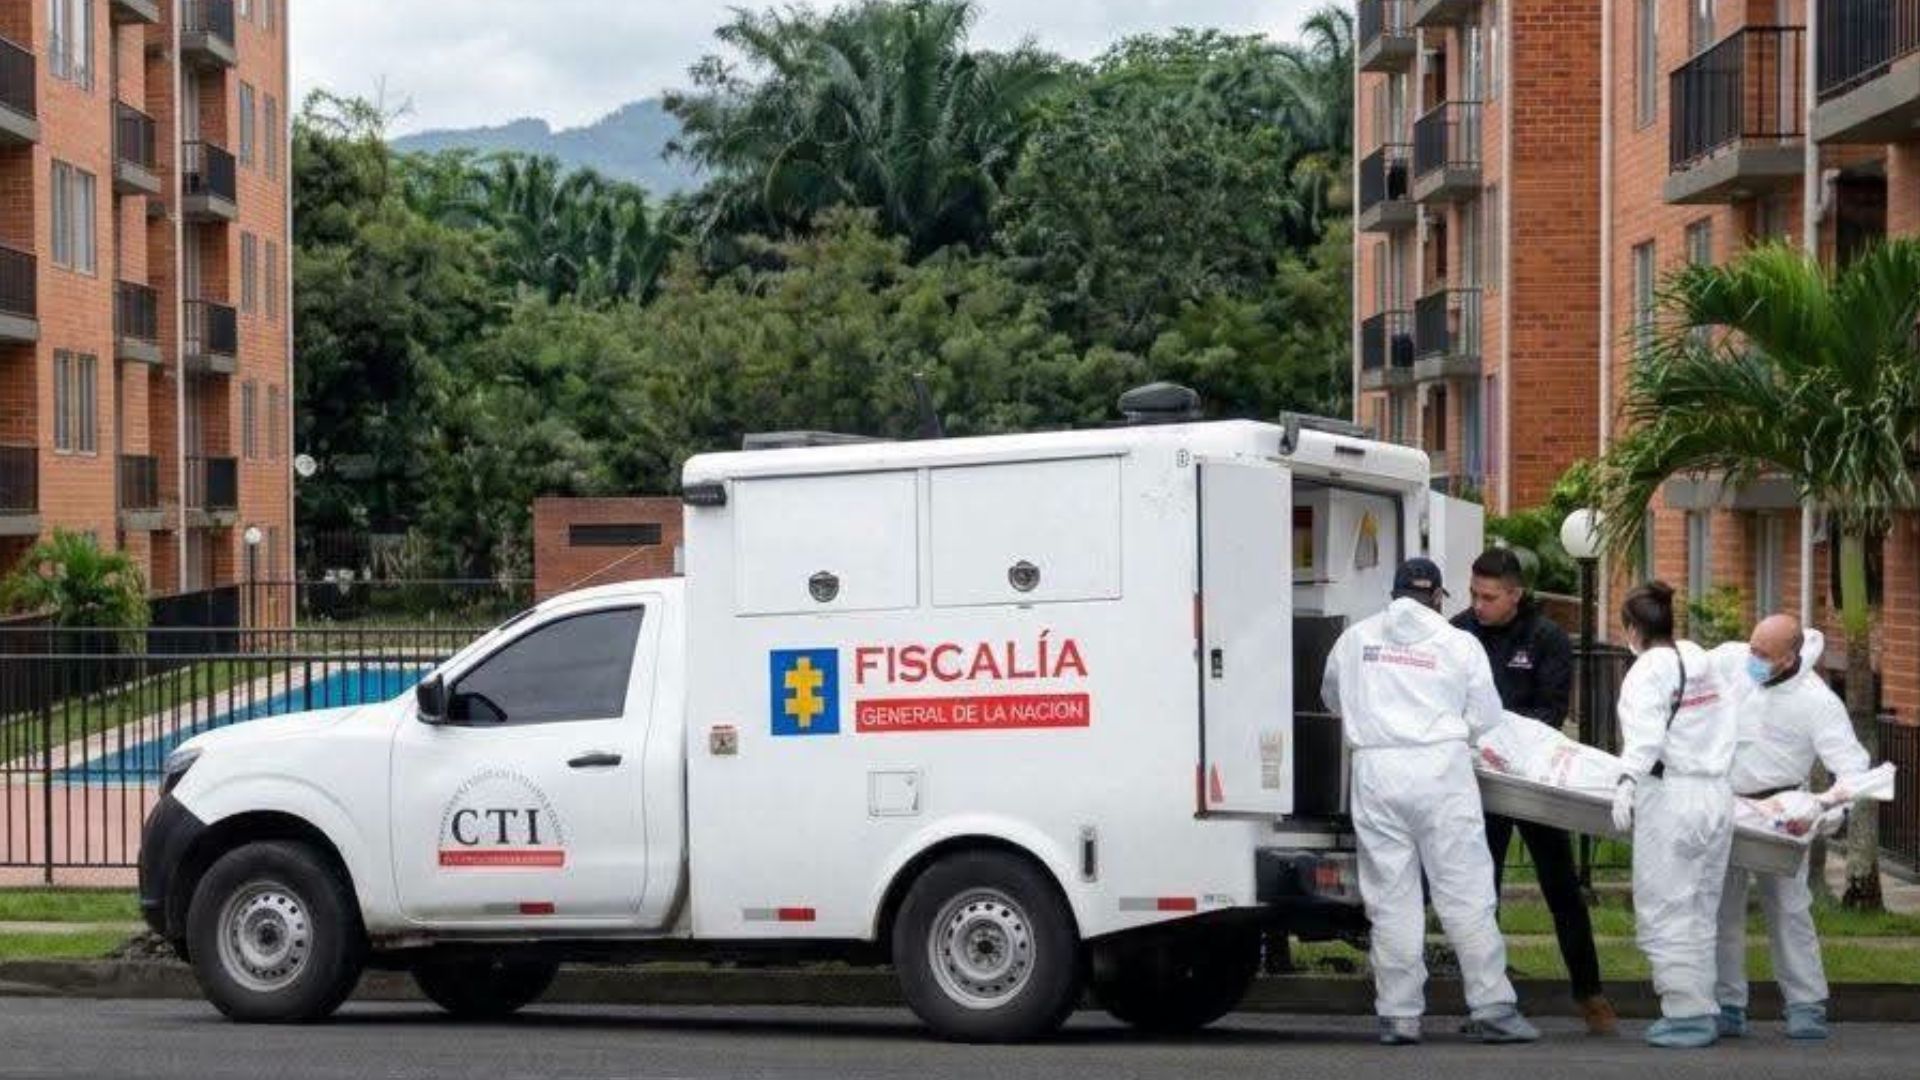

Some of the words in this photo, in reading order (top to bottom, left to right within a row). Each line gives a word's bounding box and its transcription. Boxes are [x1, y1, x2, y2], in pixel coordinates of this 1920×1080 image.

[856, 629, 1088, 684] FISCALÍA
[861, 706, 948, 725] GENERAL
[952, 704, 979, 723] DE
[983, 703, 1007, 721] LA
[451, 808, 541, 845] CTI
